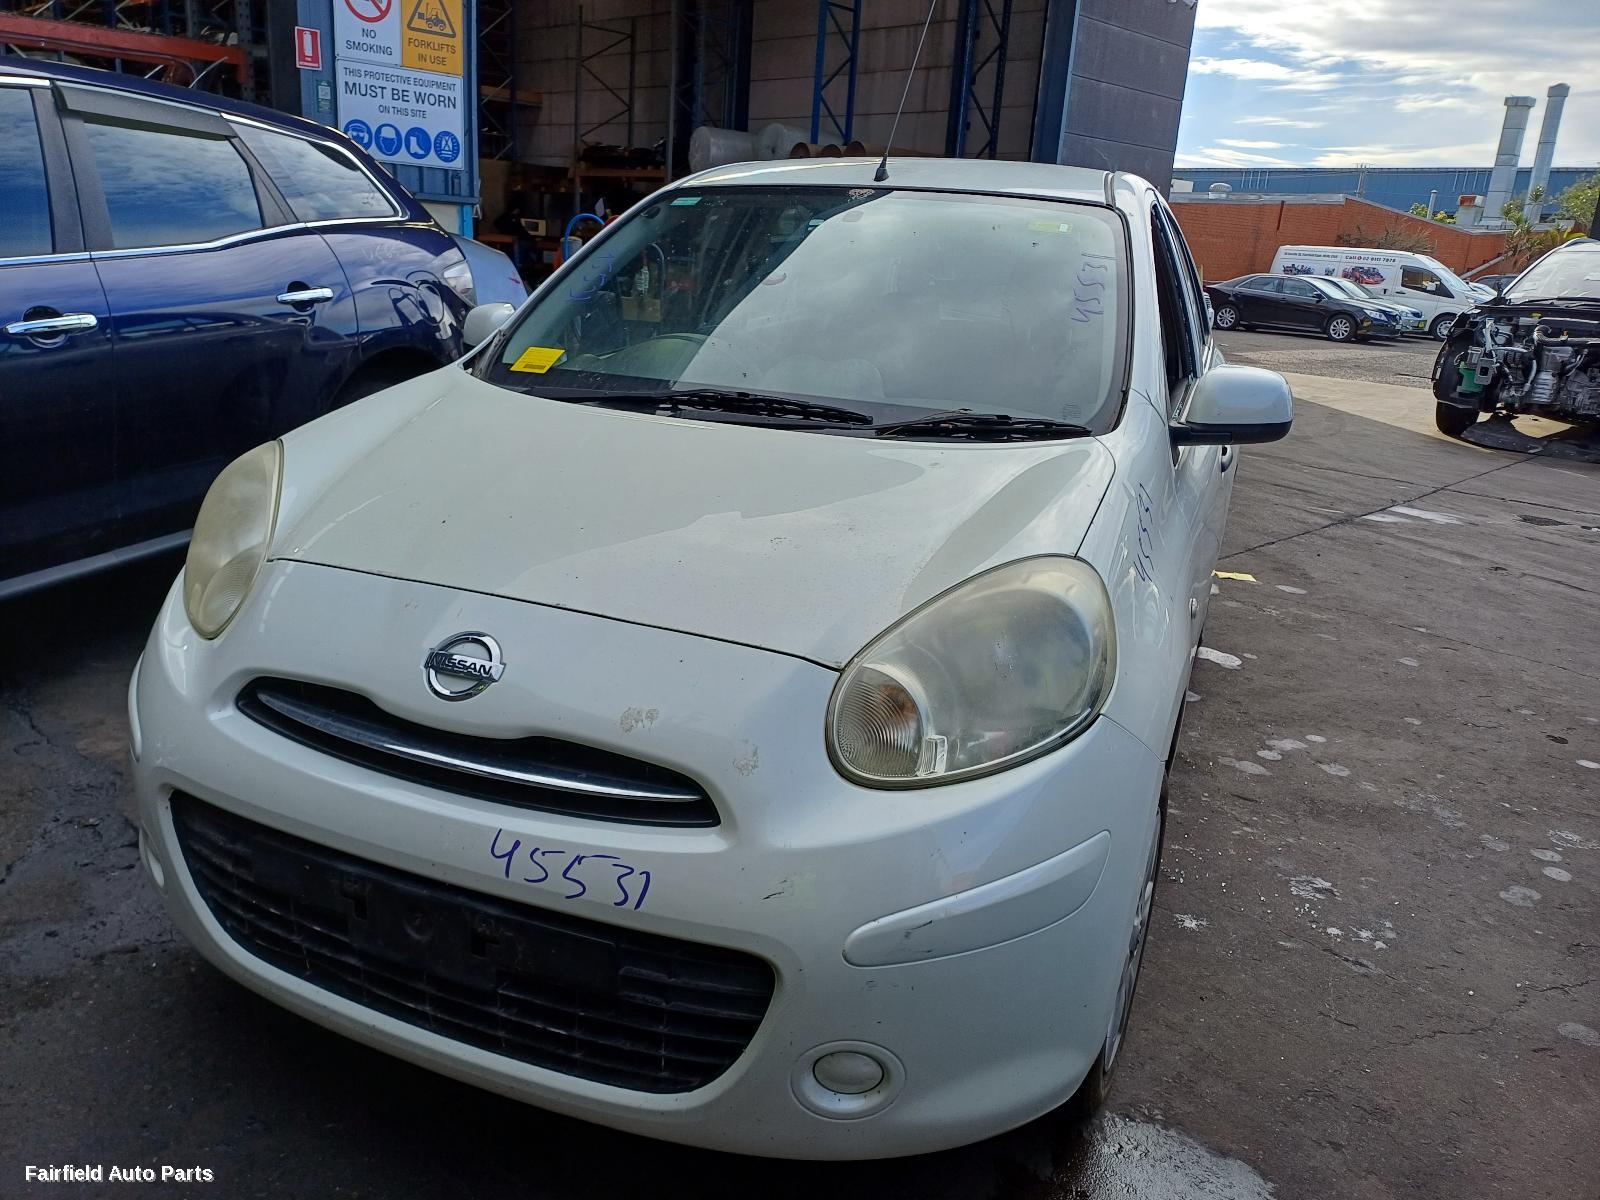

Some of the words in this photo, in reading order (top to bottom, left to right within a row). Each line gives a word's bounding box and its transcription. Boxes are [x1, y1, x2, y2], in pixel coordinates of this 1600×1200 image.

[362, 28, 376, 39] NO
[345, 40, 393, 56] SMOKING
[408, 38, 456, 54] FORKLIFTS
[418, 53, 427, 63] IN
[430, 55, 447, 65] USE
[344, 67, 362, 78] THIS
[364, 70, 412, 85] PROTECTIVE
[413, 78, 456, 91] EQUIPMENT
[344, 81, 387, 99] MUST
[391, 88, 410, 103] BE
[414, 91, 457, 109] WORN
[378, 104, 389, 115] ON
[392, 106, 409, 117] THIS
[411, 109, 427, 119] SITE
[432, 653, 493, 677] NISSAN
[490, 828, 650, 911] 45531
